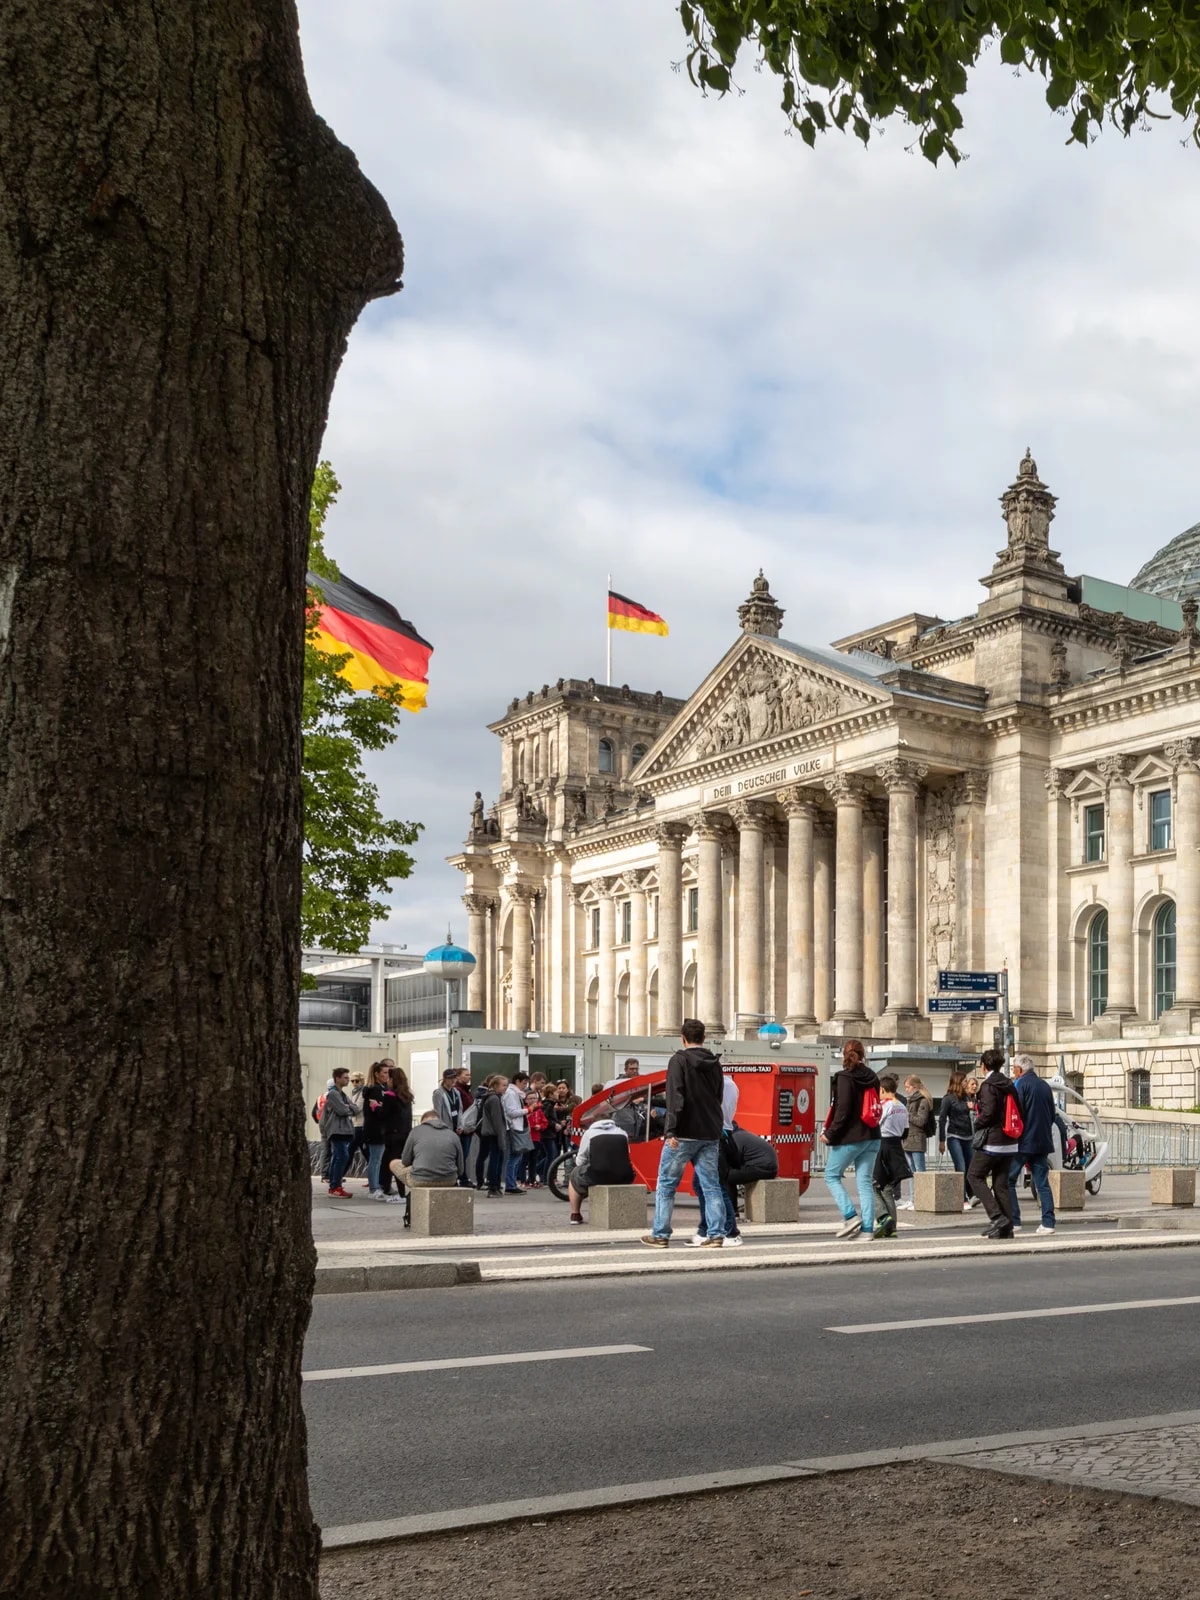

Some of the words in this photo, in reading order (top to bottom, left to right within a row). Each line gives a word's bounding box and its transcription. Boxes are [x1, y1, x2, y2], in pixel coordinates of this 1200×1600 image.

[713, 784, 732, 799] DEM
[738, 768, 787, 793] DEUTSCHEN
[793, 758, 821, 776] VOLKE
